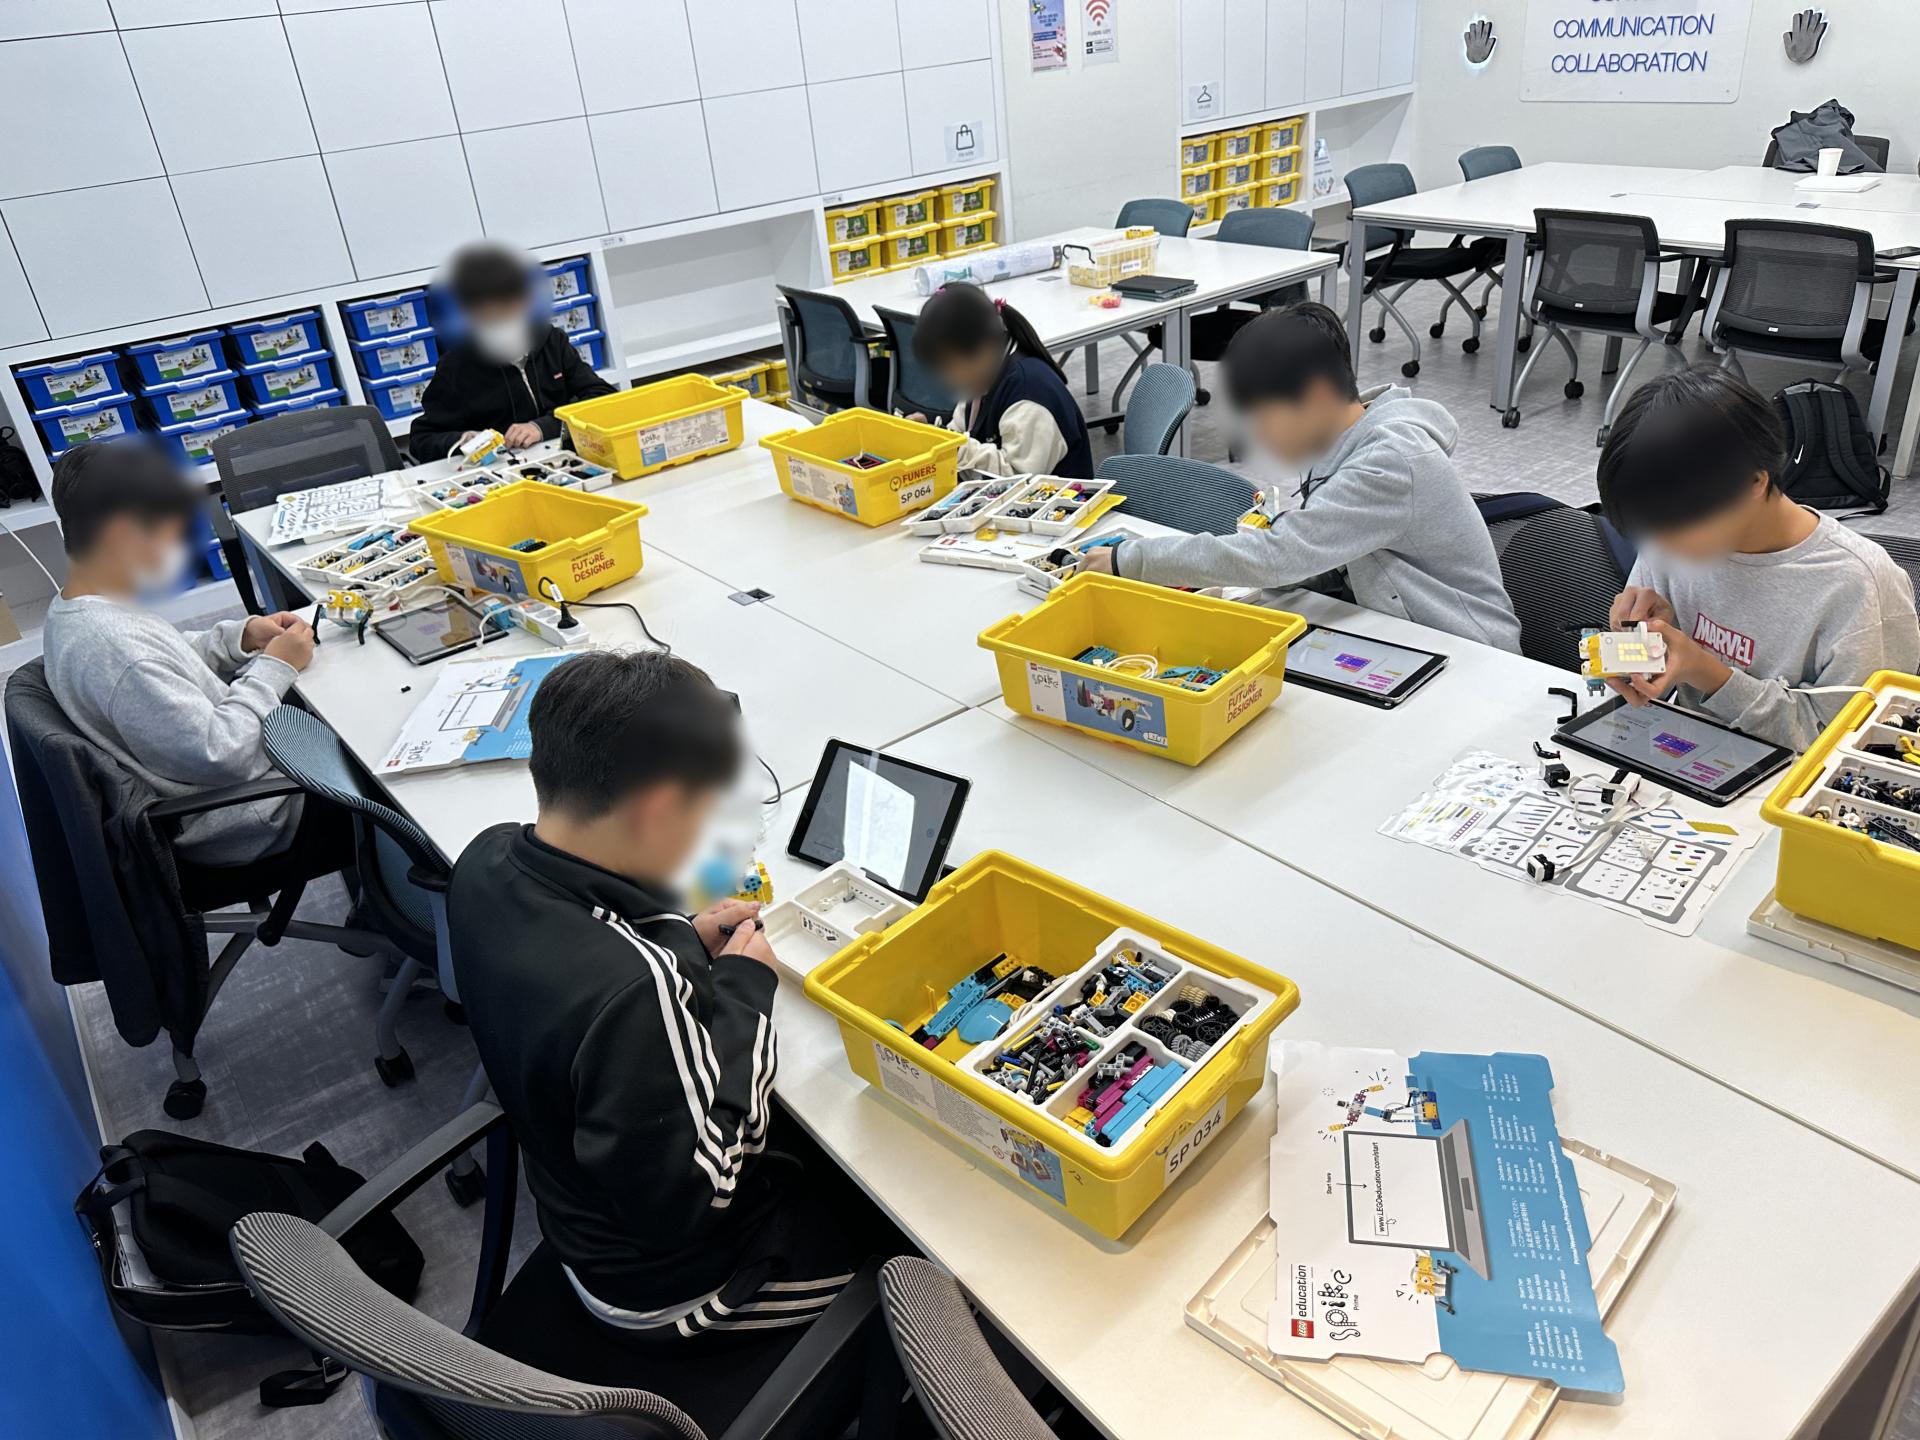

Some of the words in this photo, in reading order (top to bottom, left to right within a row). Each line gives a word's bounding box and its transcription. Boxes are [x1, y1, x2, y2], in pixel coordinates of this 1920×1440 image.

[1553, 14, 1714, 38] COMMUNICATION
[1551, 51, 1707, 73] COLLABORATION
[902, 464, 936, 483] FUNERS
[901, 492, 912, 503] SP
[914, 484, 931, 498] 064
[571, 551, 605, 573] FUTURE
[574, 558, 616, 583] DESIGNER
[1694, 614, 1752, 665] MARVEL
[1227, 688, 1263, 724] DESIGNER
[1228, 680, 1257, 711] FUTURE
[1169, 1143, 1190, 1173] SP
[1193, 1110, 1222, 1148] 034
[1372, 1142, 1385, 1232] www.LEGOeducation.com/start
[1296, 1264, 1308, 1318] education
[1317, 1269, 1361, 1341] spike
